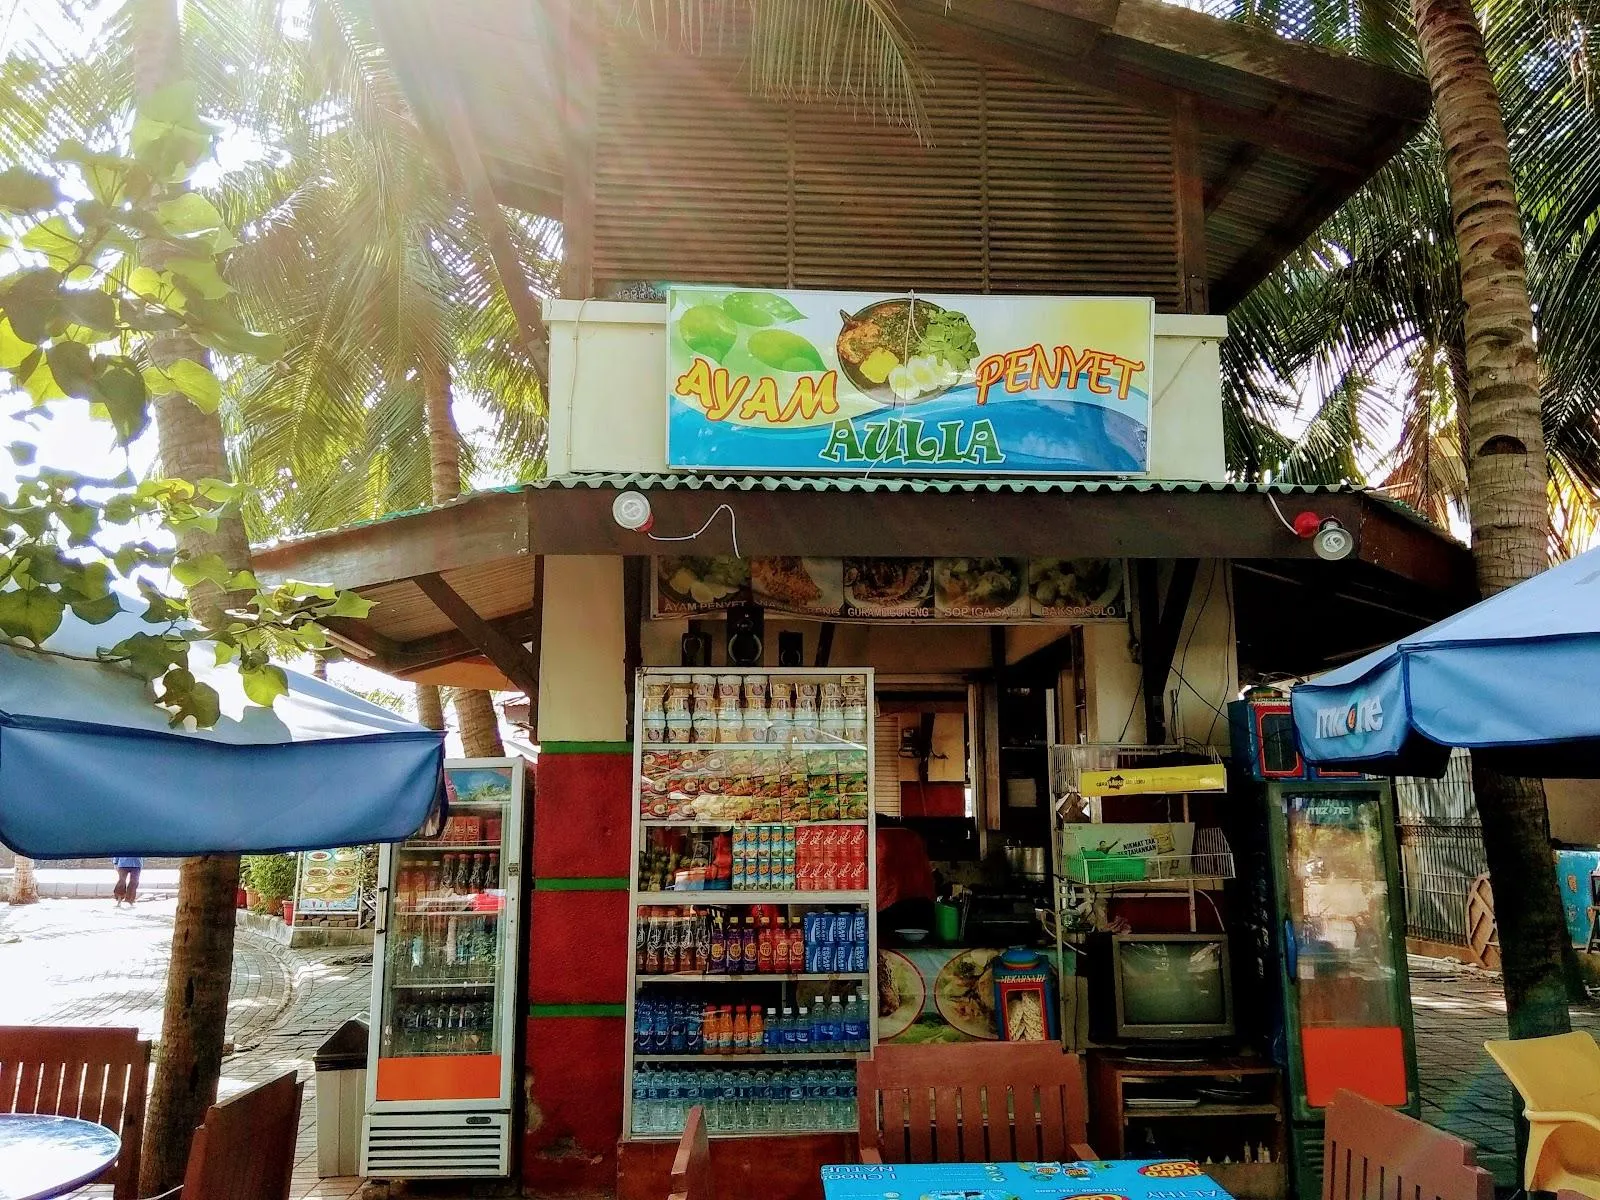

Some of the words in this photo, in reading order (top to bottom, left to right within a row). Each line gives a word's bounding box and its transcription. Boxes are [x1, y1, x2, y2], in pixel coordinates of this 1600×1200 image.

[675, 357, 839, 423] AYAM
[975, 343, 1143, 405] PENYET
[819, 418, 1004, 464] AULIA
[664, 600, 697, 612] AYAM
[944, 607, 969, 617] SOP
[1085, 606, 1116, 616] SOLO
